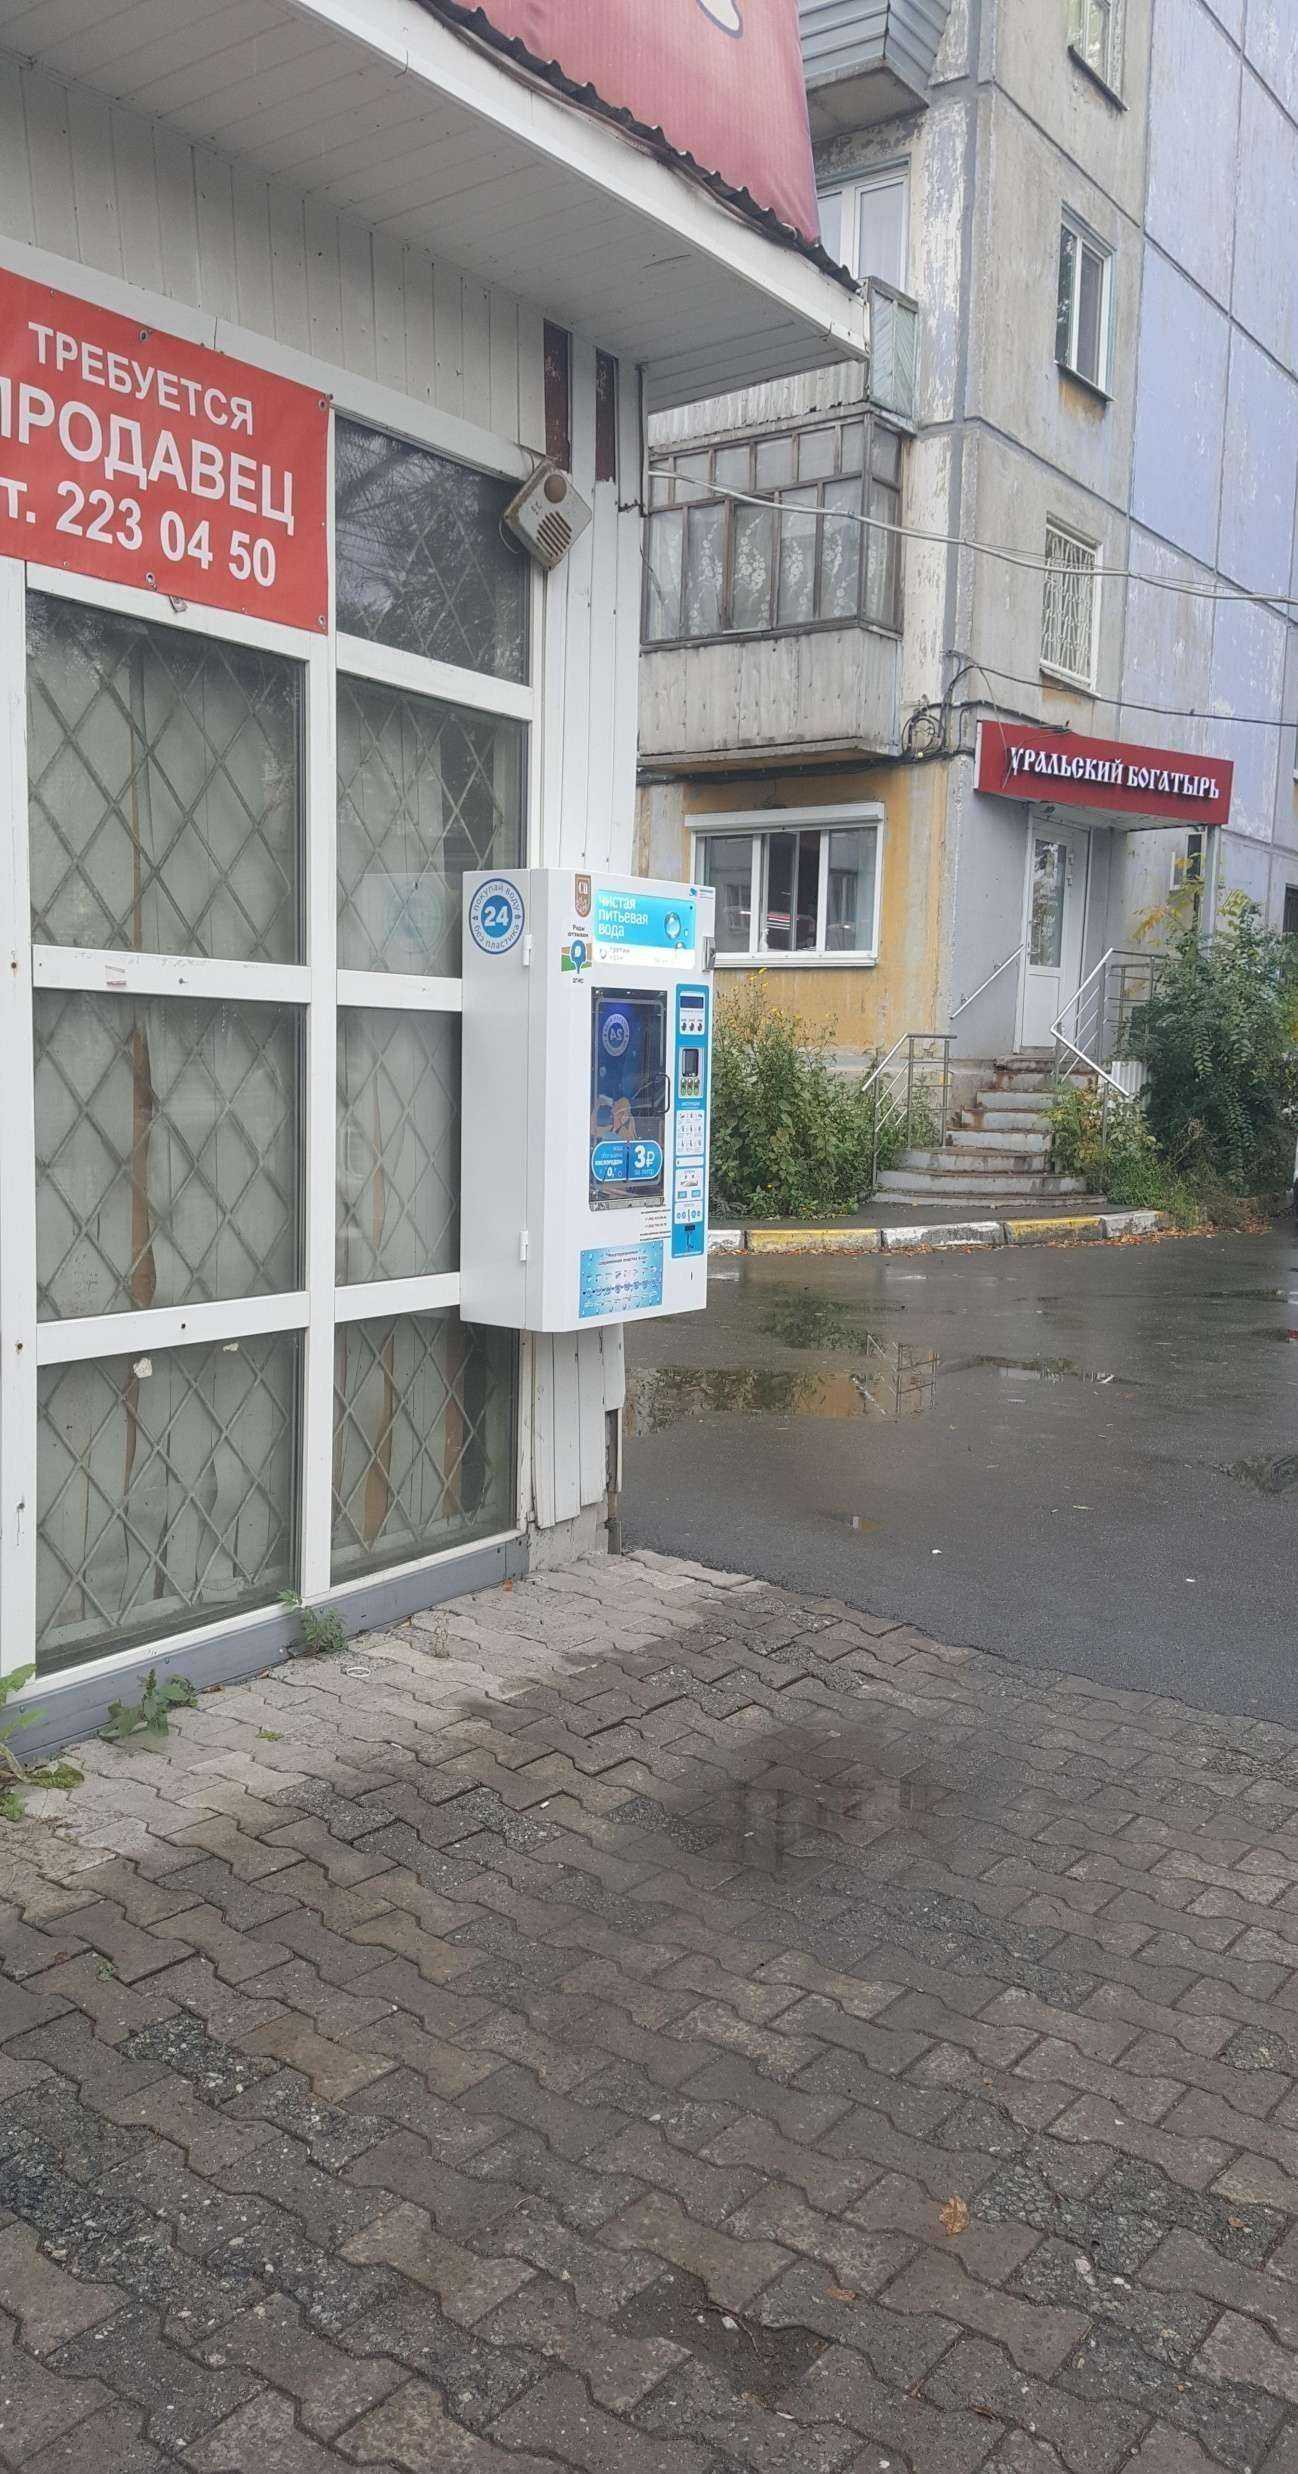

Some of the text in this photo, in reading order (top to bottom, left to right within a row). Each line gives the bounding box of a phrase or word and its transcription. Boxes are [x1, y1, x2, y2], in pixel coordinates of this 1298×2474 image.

[28, 321, 253, 436] ТРЕБУЕТСЯ
[56, 480, 143, 550] 223
[160, 510, 213, 570] 04
[228, 530, 276, 587] 50
[1010, 746, 1220, 799] УРАЛЬСКИЙ БОГАТЫРЬ
[484, 905, 509, 927] 24
[505, 887, 521, 911] воду
